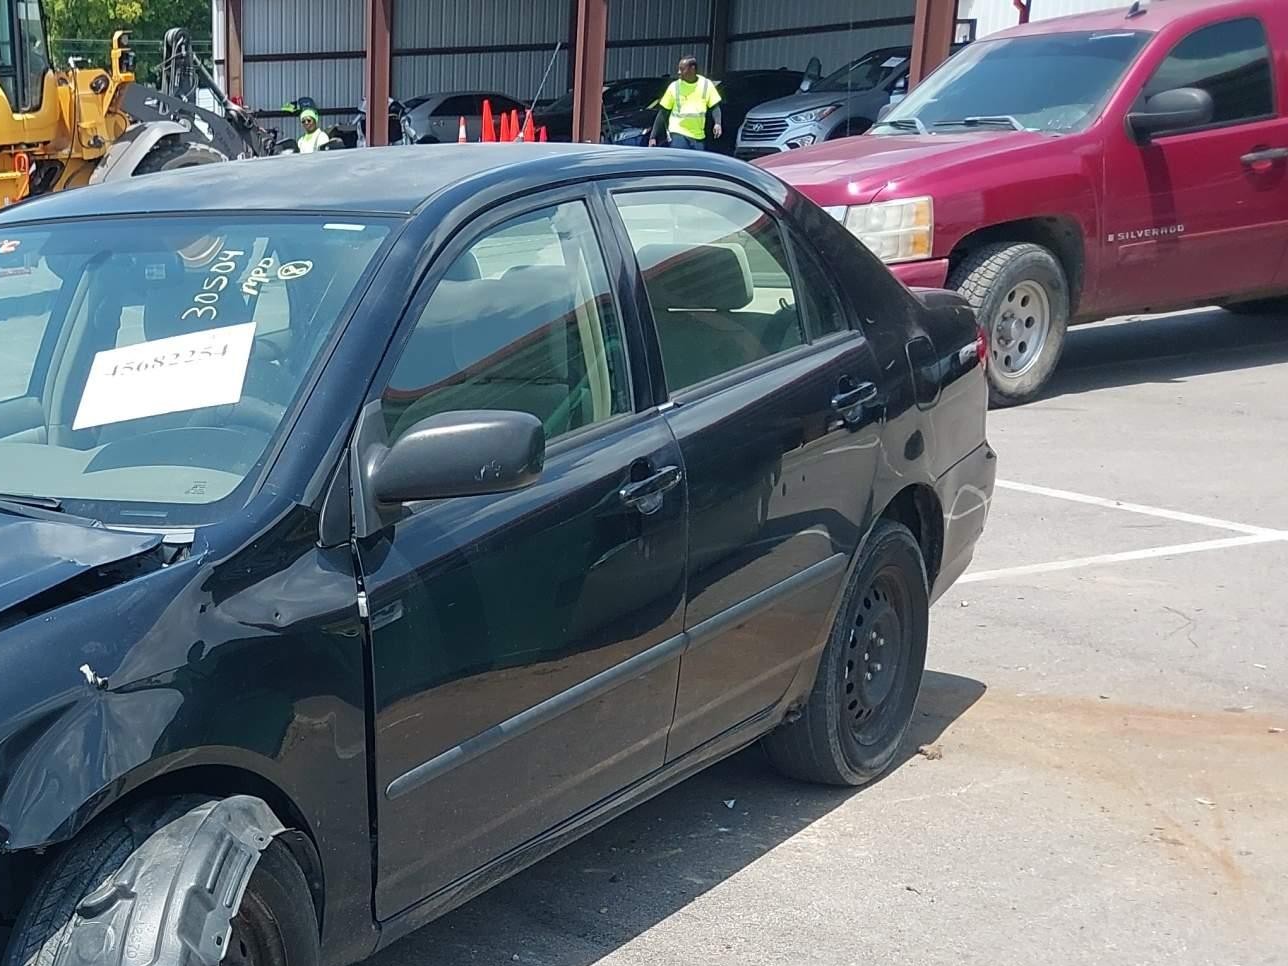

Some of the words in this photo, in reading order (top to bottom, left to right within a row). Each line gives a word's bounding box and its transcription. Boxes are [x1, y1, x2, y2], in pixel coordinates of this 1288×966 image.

[1117, 224, 1185, 240] SILVERADO
[181, 249, 244, 320] 30504
[104, 343, 228, 376] 45682254
